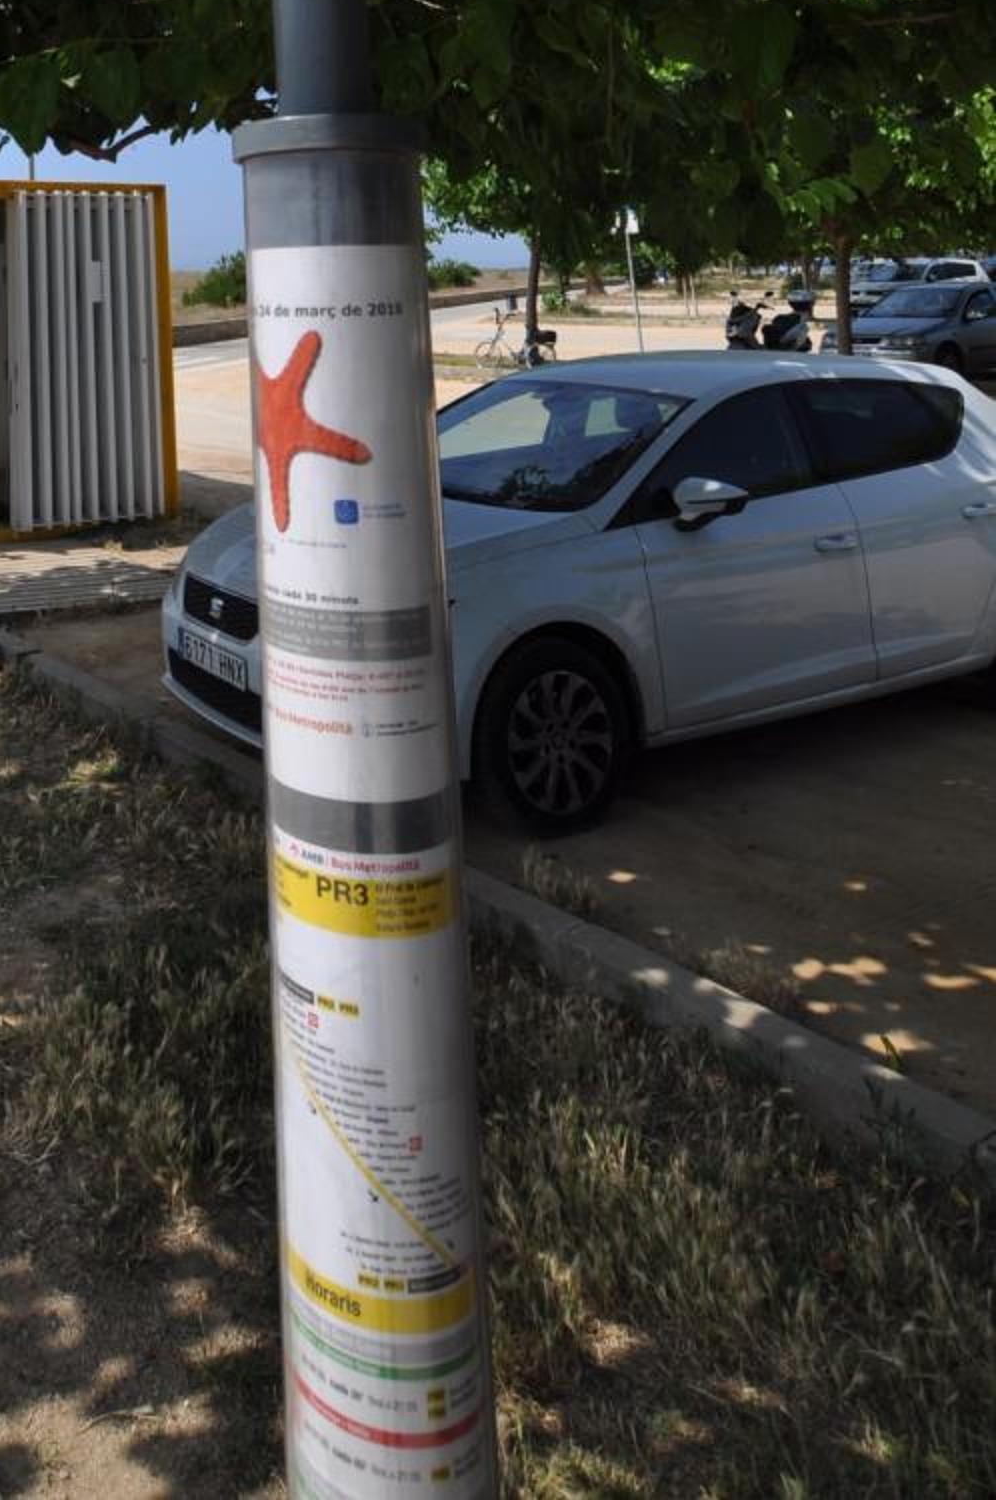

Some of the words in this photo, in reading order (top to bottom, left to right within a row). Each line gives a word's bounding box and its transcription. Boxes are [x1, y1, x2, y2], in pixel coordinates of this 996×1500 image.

[295, 306, 336, 319] març
[342, 303, 363, 317] de
[316, 874, 370, 907] PR3
